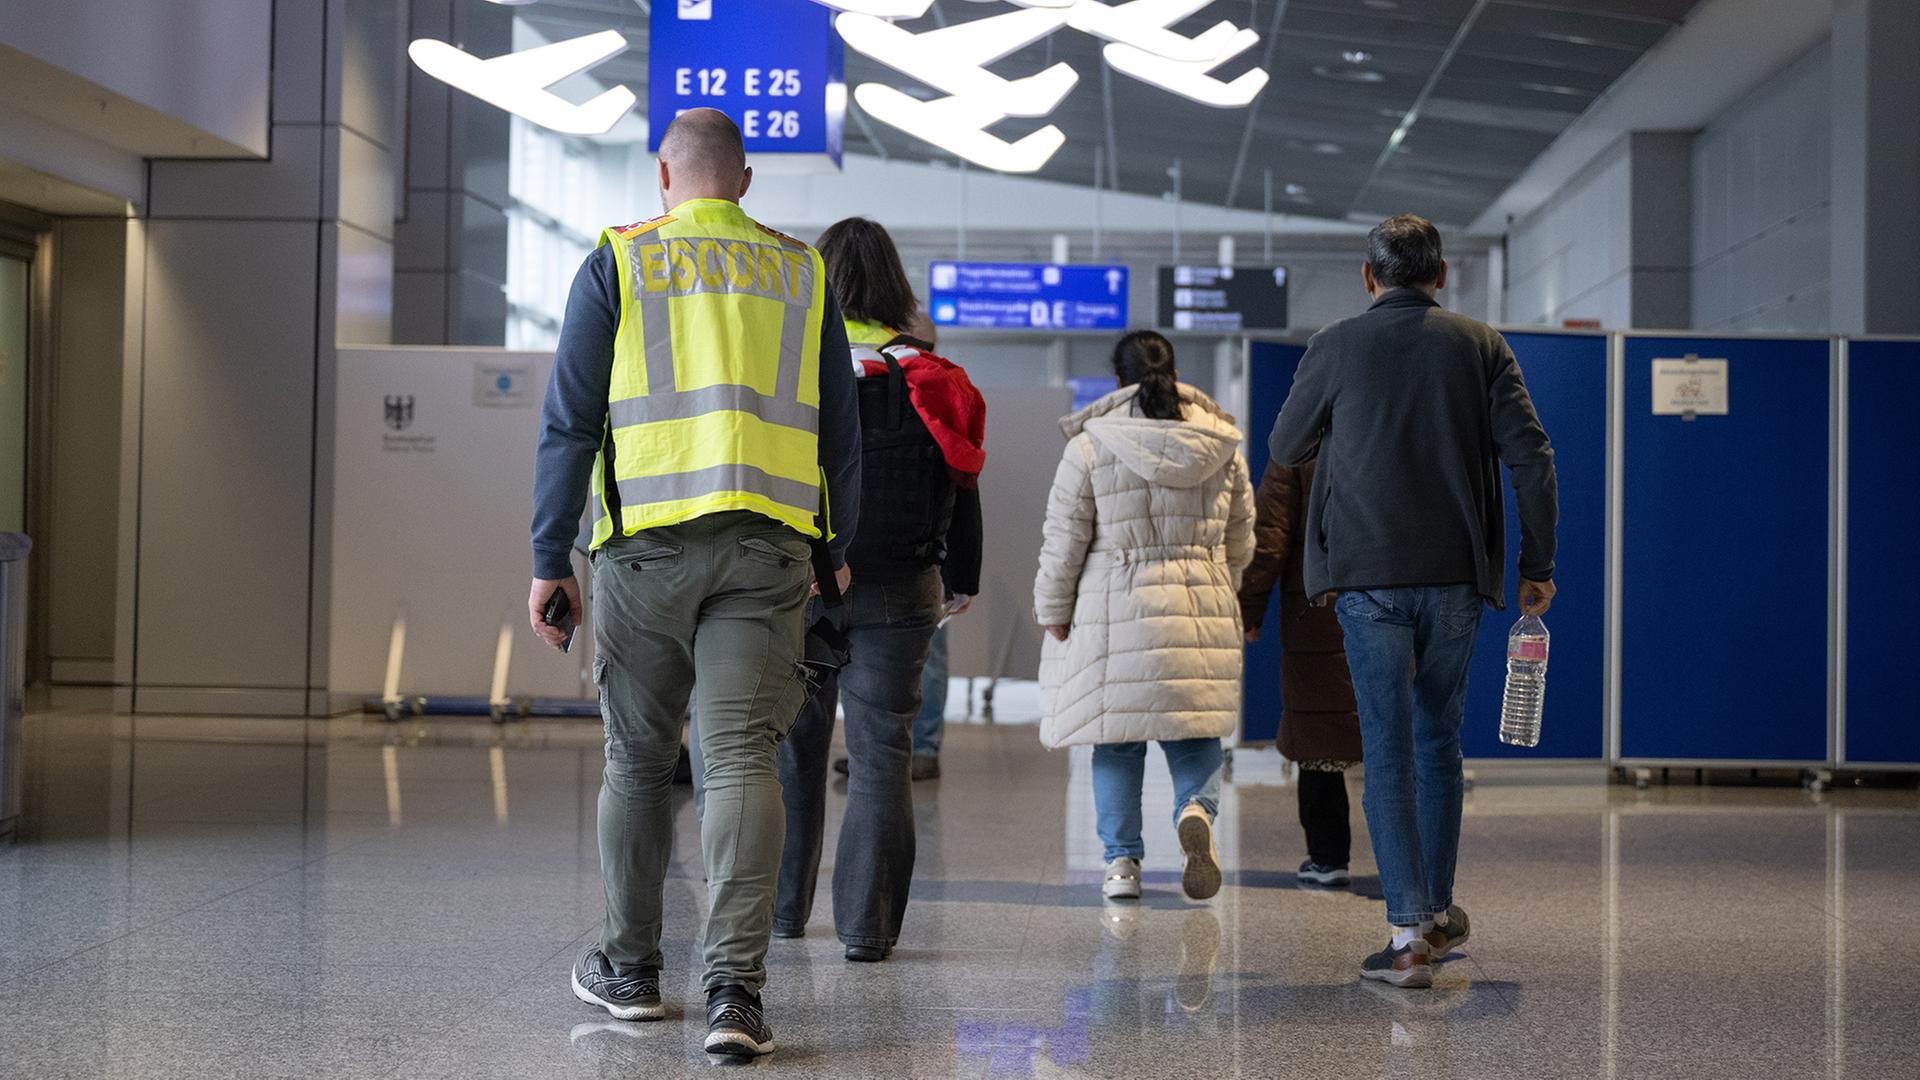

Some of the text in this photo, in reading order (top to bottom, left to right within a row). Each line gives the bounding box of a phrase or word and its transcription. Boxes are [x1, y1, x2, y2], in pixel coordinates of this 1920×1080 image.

[676, 68, 727, 96] E 12
[744, 68, 800, 96] E 25
[744, 110, 799, 138] E 26
[639, 239, 806, 298] ESCORT
